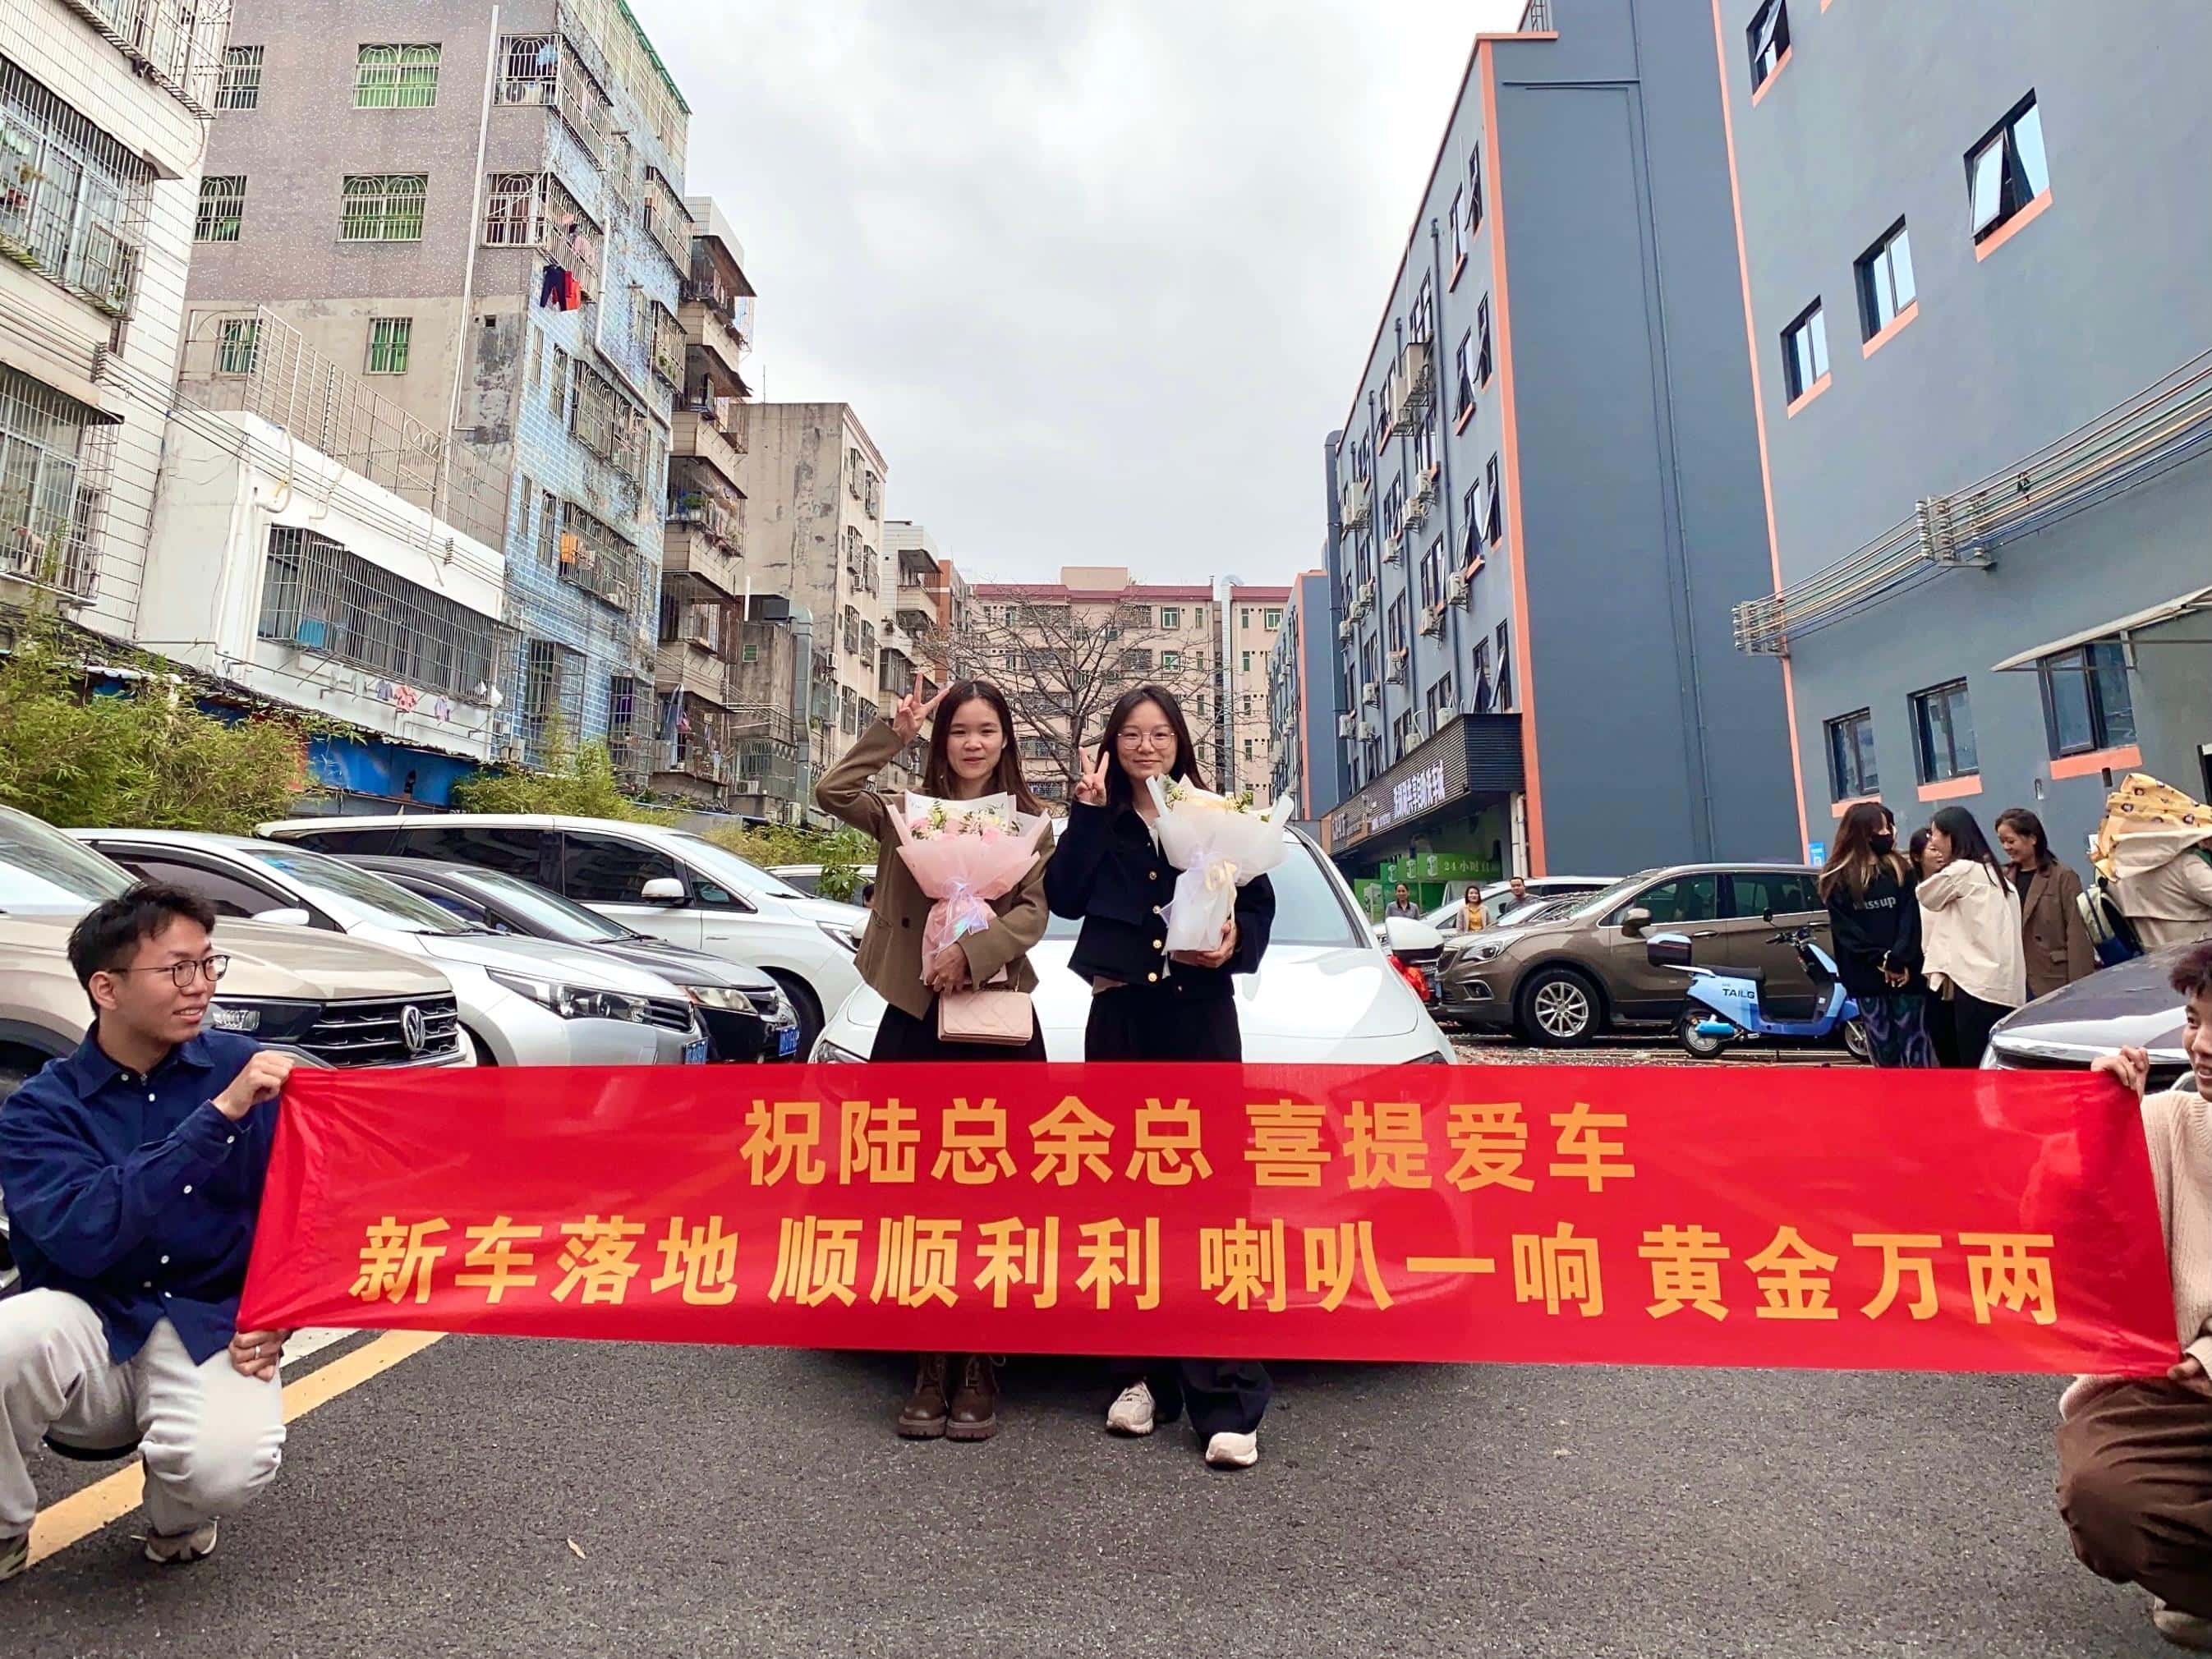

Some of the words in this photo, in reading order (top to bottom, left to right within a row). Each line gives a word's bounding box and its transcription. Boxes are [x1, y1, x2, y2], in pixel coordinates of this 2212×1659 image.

[1722, 988, 1755, 1000] TAILG
[741, 1097, 1212, 1186] 祝陆总余总
[1244, 1101, 1636, 1192] 喜提爱车
[348, 1215, 738, 1306] 新车落地
[767, 1216, 1161, 1309] 顺顺利利
[1198, 1220, 1604, 1317] 喇叭一响
[1637, 1225, 2058, 1325] 黄金万两
